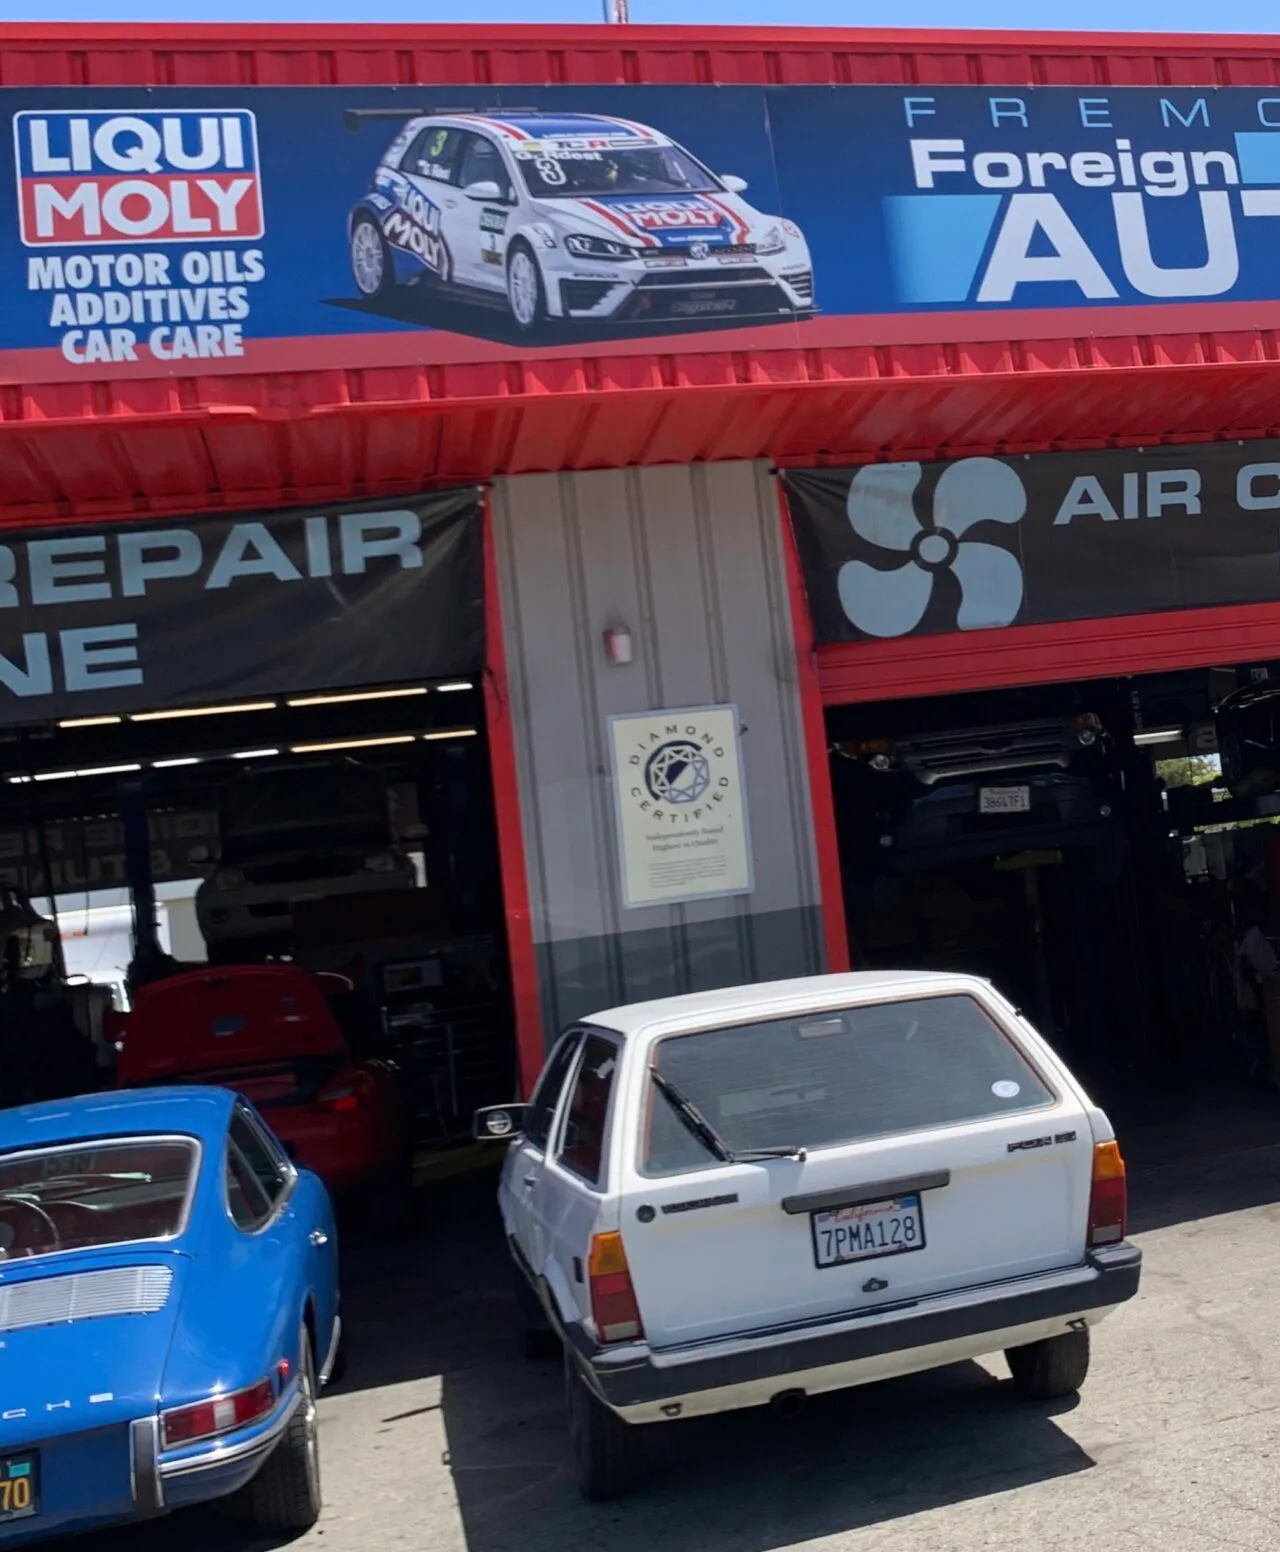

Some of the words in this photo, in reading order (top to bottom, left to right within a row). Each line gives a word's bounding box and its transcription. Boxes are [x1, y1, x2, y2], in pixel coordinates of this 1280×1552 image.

[29, 116, 245, 174] LIQUI
[430, 130, 448, 157] 3
[535, 157, 567, 186] 3
[910, 138, 1240, 197] Foreign
[33, 179, 254, 237] MOLY
[632, 209, 724, 227] MOLY
[384, 213, 441, 267] MOLY
[28, 253, 171, 290] MOTOR
[182, 249, 265, 285] OILS
[50, 286, 250, 327] ADDITIVES
[61, 328, 139, 364] CAR
[149, 323, 245, 360] CARE
[1053, 468, 1201, 525] AIR
[0, 509, 423, 608] EPAIR
[629, 724, 726, 766] DIAMOND
[630, 776, 729, 823] CERTIFIED
[820, 1215, 916, 1257] 7PMA128
